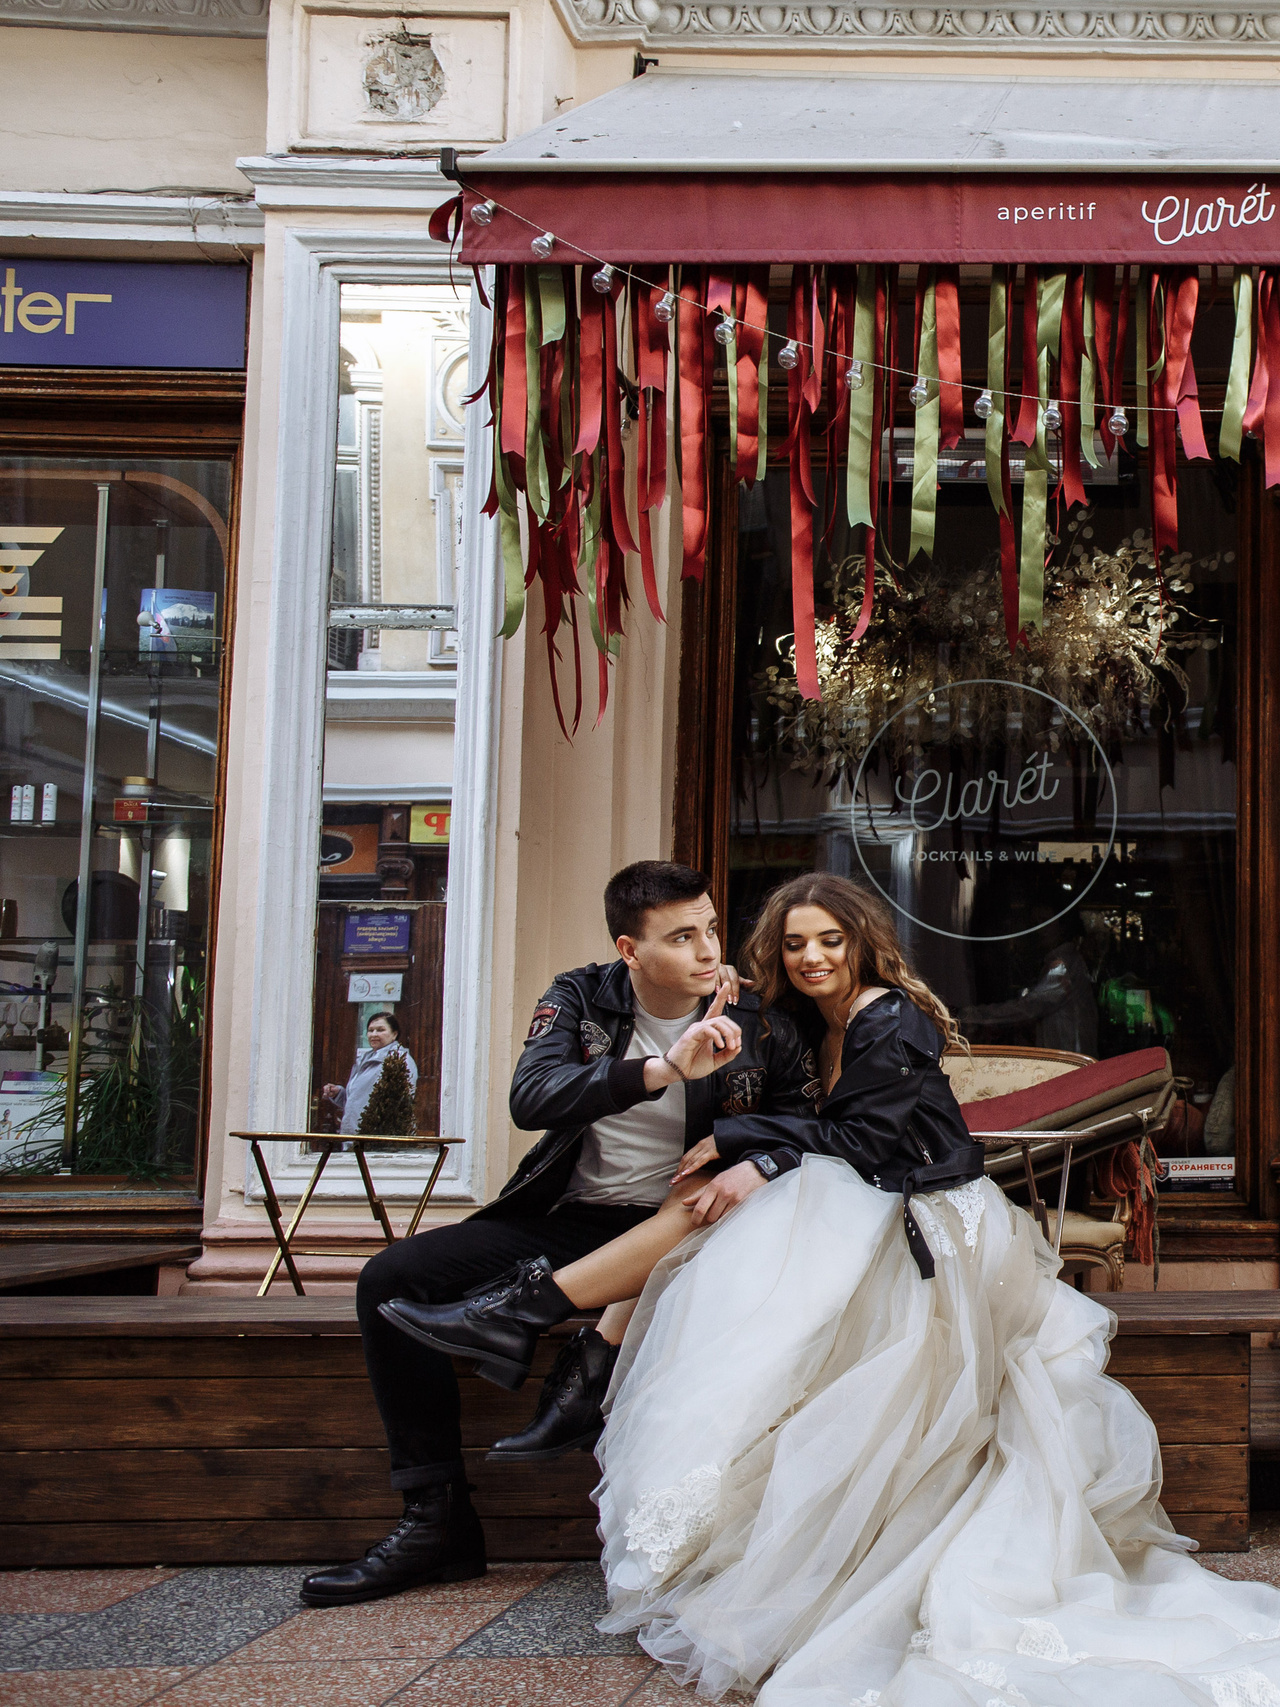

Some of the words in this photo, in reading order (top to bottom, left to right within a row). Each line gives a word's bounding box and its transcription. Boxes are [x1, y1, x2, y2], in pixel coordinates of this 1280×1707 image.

[997, 202, 1097, 224] aperitif
[1142, 182, 1276, 246] Clarét
[0, 268, 112, 335] ter
[895, 750, 1059, 832] Clarét
[998, 850, 1009, 862] &
[1015, 850, 1058, 862] WINE
[1171, 1163, 1233, 1171] ОХРАНЯЕТСЯ
